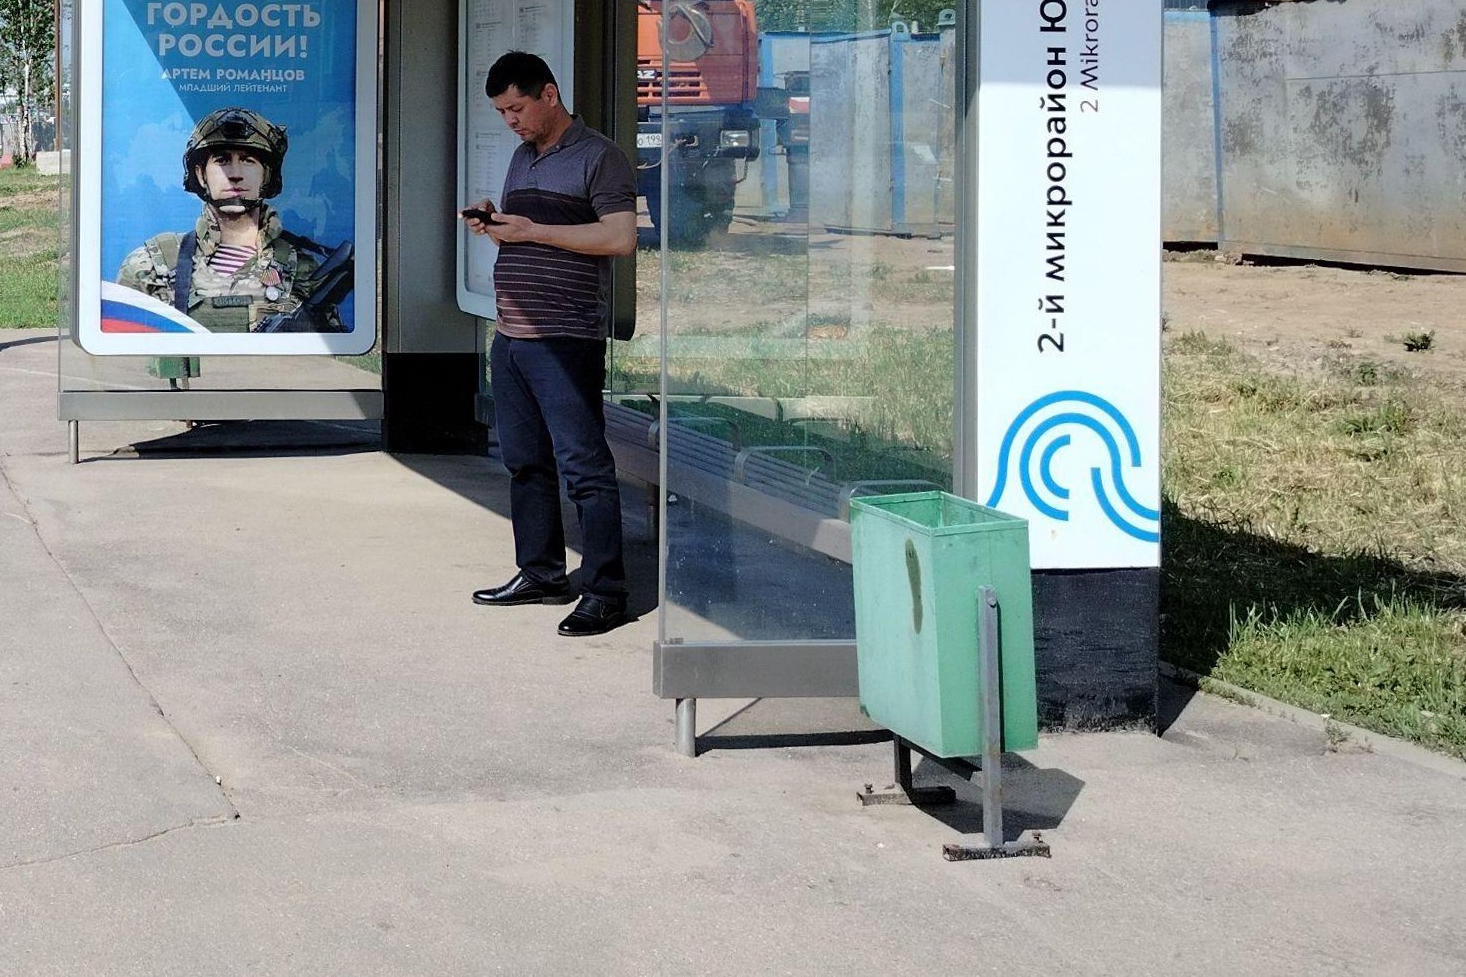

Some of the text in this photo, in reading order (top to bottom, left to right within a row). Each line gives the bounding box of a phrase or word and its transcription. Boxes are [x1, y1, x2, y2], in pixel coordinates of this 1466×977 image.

[147, 2, 321, 29] ГОРДОСТЬ
[158, 33, 308, 59] РОССИИ!
[161, 68, 305, 82] АРТЕМ РОМАНЦОВ
[178, 83, 288, 93] МЛАДШИЙ ЛЕЙТЕНАНТ
[1080, 99, 1099, 113] 2
[1039, 47, 1073, 282] микрорайон
[1037, 294, 1065, 354] 2-й
